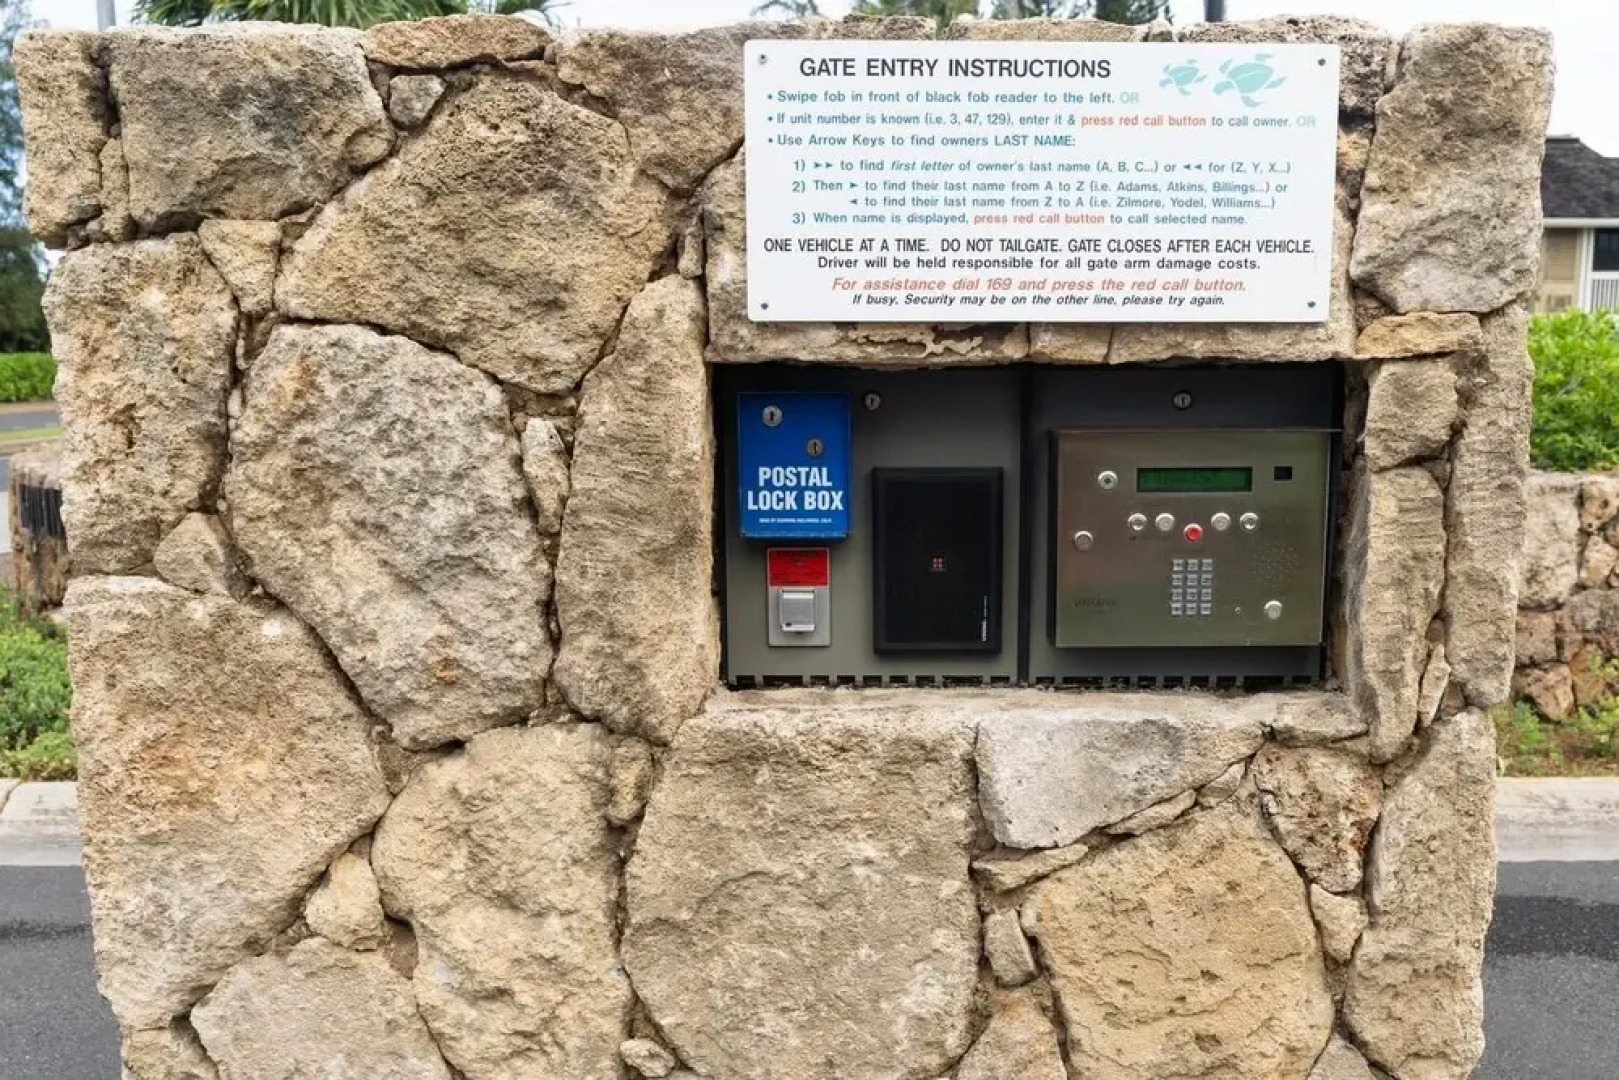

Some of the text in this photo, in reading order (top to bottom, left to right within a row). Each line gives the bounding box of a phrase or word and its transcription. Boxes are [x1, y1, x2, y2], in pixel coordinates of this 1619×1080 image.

[799, 58, 1111, 78] GATE ENTRY INSTRUCTIONS
[777, 90, 1139, 104] Swipe fob in front of black fob reader to the left. OR
[777, 112, 786, 123] If
[790, 113, 812, 124] unit
[817, 113, 862, 124] number
[866, 113, 876, 125] is
[880, 114, 920, 125] known
[924, 113, 946, 125] (i.e.
[1018, 115, 1050, 125] enter
[1054, 115, 1062, 125] it
[1067, 114, 1076, 125] &
[1081, 116, 1114, 128] press
[1119, 115, 1139, 126] red
[1143, 115, 1164, 126] call
[1168, 115, 1206, 126] button
[1211, 116, 1224, 126] to
[1228, 115, 1249, 127] call
[1297, 116, 1316, 127] OR
[777, 134, 1075, 147] Use Arrow Keys to find owners LAST NAME:
[793, 159, 806, 172] 1)
[840, 160, 854, 171] to
[859, 160, 884, 170] find
[890, 160, 918, 171] first
[921, 161, 955, 171] letter
[958, 160, 974, 171] of
[976, 162, 1024, 171] owner's
[1029, 162, 1053, 171] last
[1057, 163, 1091, 172] name
[1164, 164, 1177, 173] or
[1208, 162, 1226, 173] for
[792, 180, 806, 193] 2)
[812, 180, 843, 191] Then
[865, 181, 878, 191] to
[883, 181, 906, 191] find
[911, 181, 939, 191] their
[944, 181, 967, 191] last
[972, 183, 1006, 191] name
[1011, 181, 1040, 191] from
[1044, 181, 1053, 191] A
[1059, 181, 1071, 191] to
[1075, 181, 1085, 191] Z
[1089, 180, 1111, 192] (i.e.
[1117, 181, 1161, 192] Adams,
[1166, 181, 1207, 192] Atkins,
[1274, 184, 1288, 193] or
[864, 197, 878, 206] to
[883, 196, 905, 206] find
[911, 196, 939, 206] their
[944, 196, 966, 206] last
[972, 199, 1005, 207] name
[1011, 196, 1039, 207] from
[1044, 196, 1053, 207] Z
[1058, 198, 1070, 207] to
[1075, 197, 1084, 207] A
[1089, 196, 1111, 207] (i.e.
[1116, 196, 1164, 208] Zilmore,
[1170, 197, 1206, 208] Yodel,
[792, 212, 1247, 225] 3) When name is displayed, press red call button to call selected name.
[764, 238, 1315, 253] ONE VEHICLE AT A TIME. DO NOT TAILGATE. GATE CLOSES AFTER EACH VEHICLE.
[817, 256, 1260, 272] Driver will be held responsible for all gate arm damage costs.
[832, 277, 1245, 293] For assistance dial 169 and press the red call button.
[852, 294, 863, 304] If
[866, 295, 899, 306] busy.
[904, 293, 956, 306] Security
[960, 296, 986, 306] may
[990, 294, 1006, 305] be
[1011, 296, 1027, 305] on
[1031, 295, 1051, 305] the
[1056, 295, 1089, 305] other
[1122, 295, 1163, 306] please
[1169, 295, 1185, 306] try
[1190, 295, 1224, 307] again.
[759, 466, 832, 487] POSTAL
[747, 490, 844, 511] LOCK BOX
